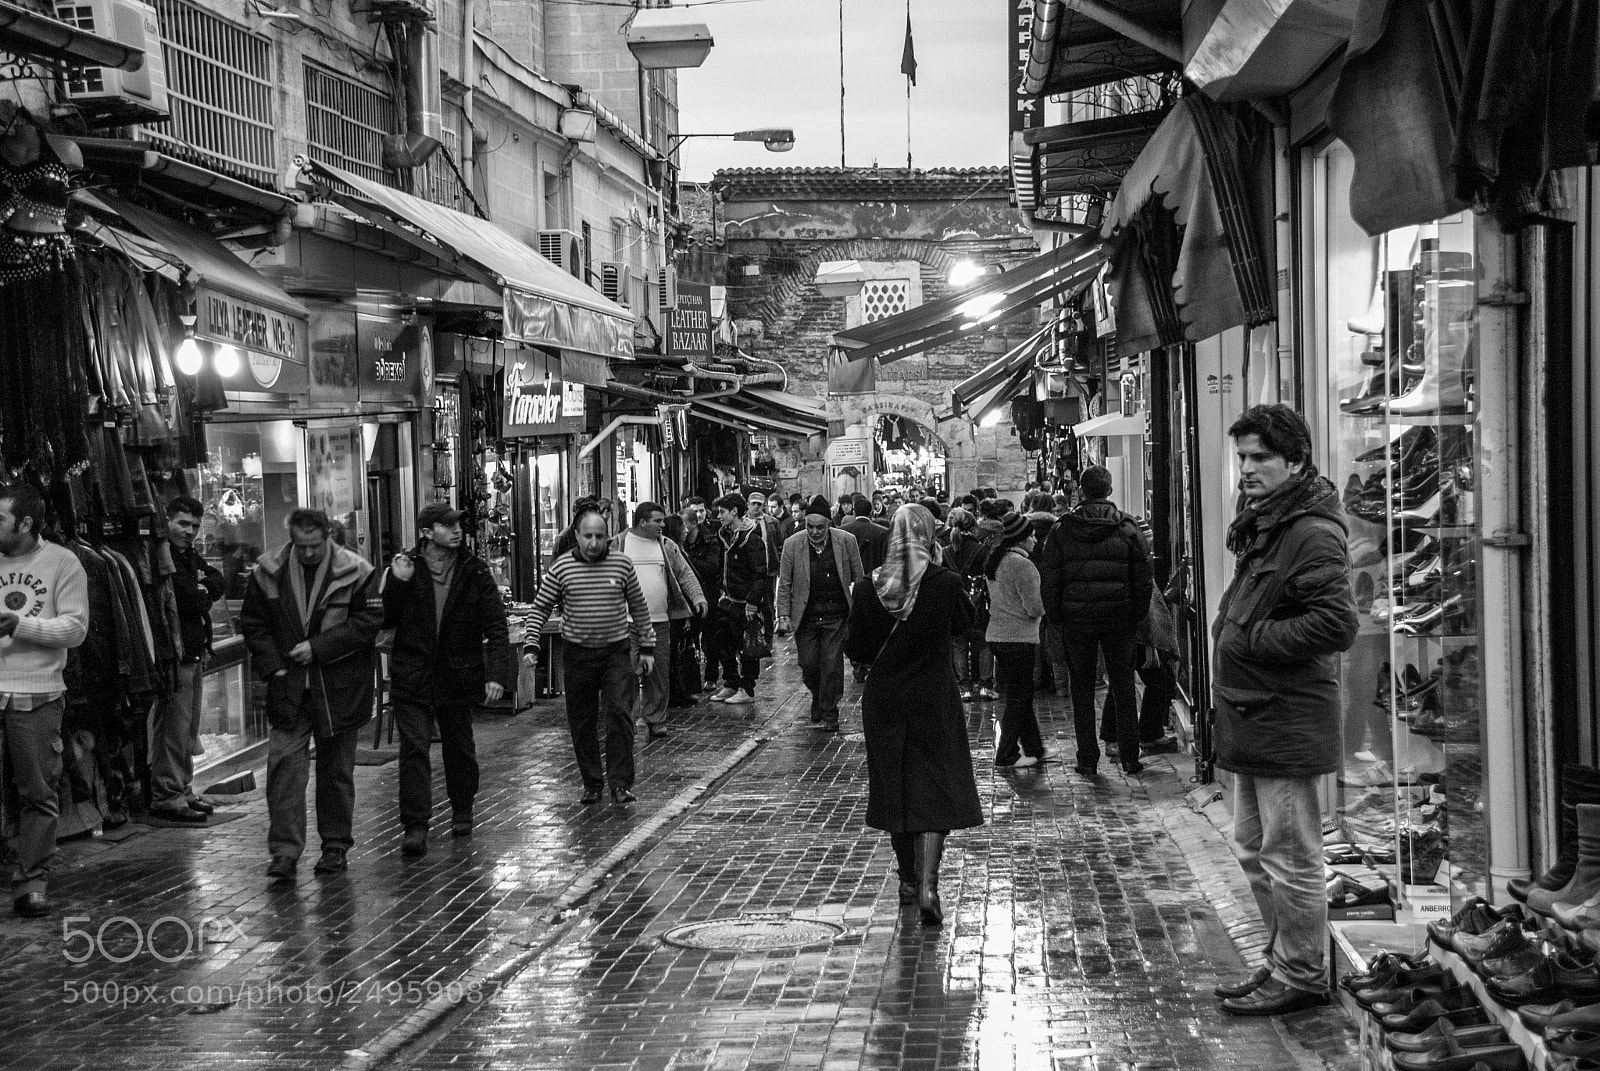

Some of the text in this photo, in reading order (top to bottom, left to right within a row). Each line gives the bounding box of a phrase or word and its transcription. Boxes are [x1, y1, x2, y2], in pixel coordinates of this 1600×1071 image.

[671, 309, 709, 330] LEATHER
[672, 331, 708, 351] BAZAAR
[0, 573, 47, 596] LFIGER
